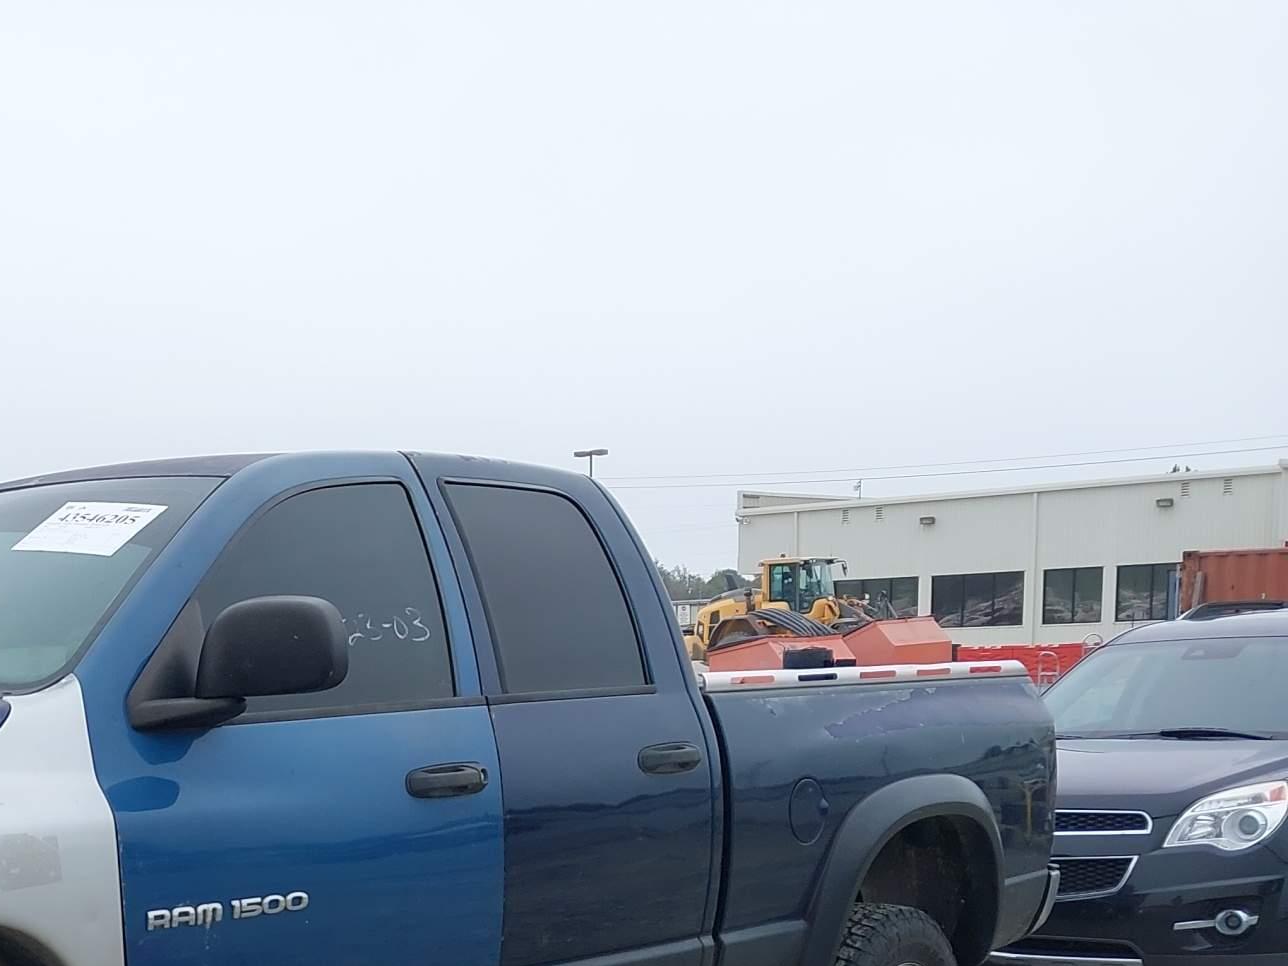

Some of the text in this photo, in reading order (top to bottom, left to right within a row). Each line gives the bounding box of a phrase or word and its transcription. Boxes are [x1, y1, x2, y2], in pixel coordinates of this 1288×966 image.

[58, 512, 142, 525] 43546205
[147, 891, 310, 932] RAM 1500
